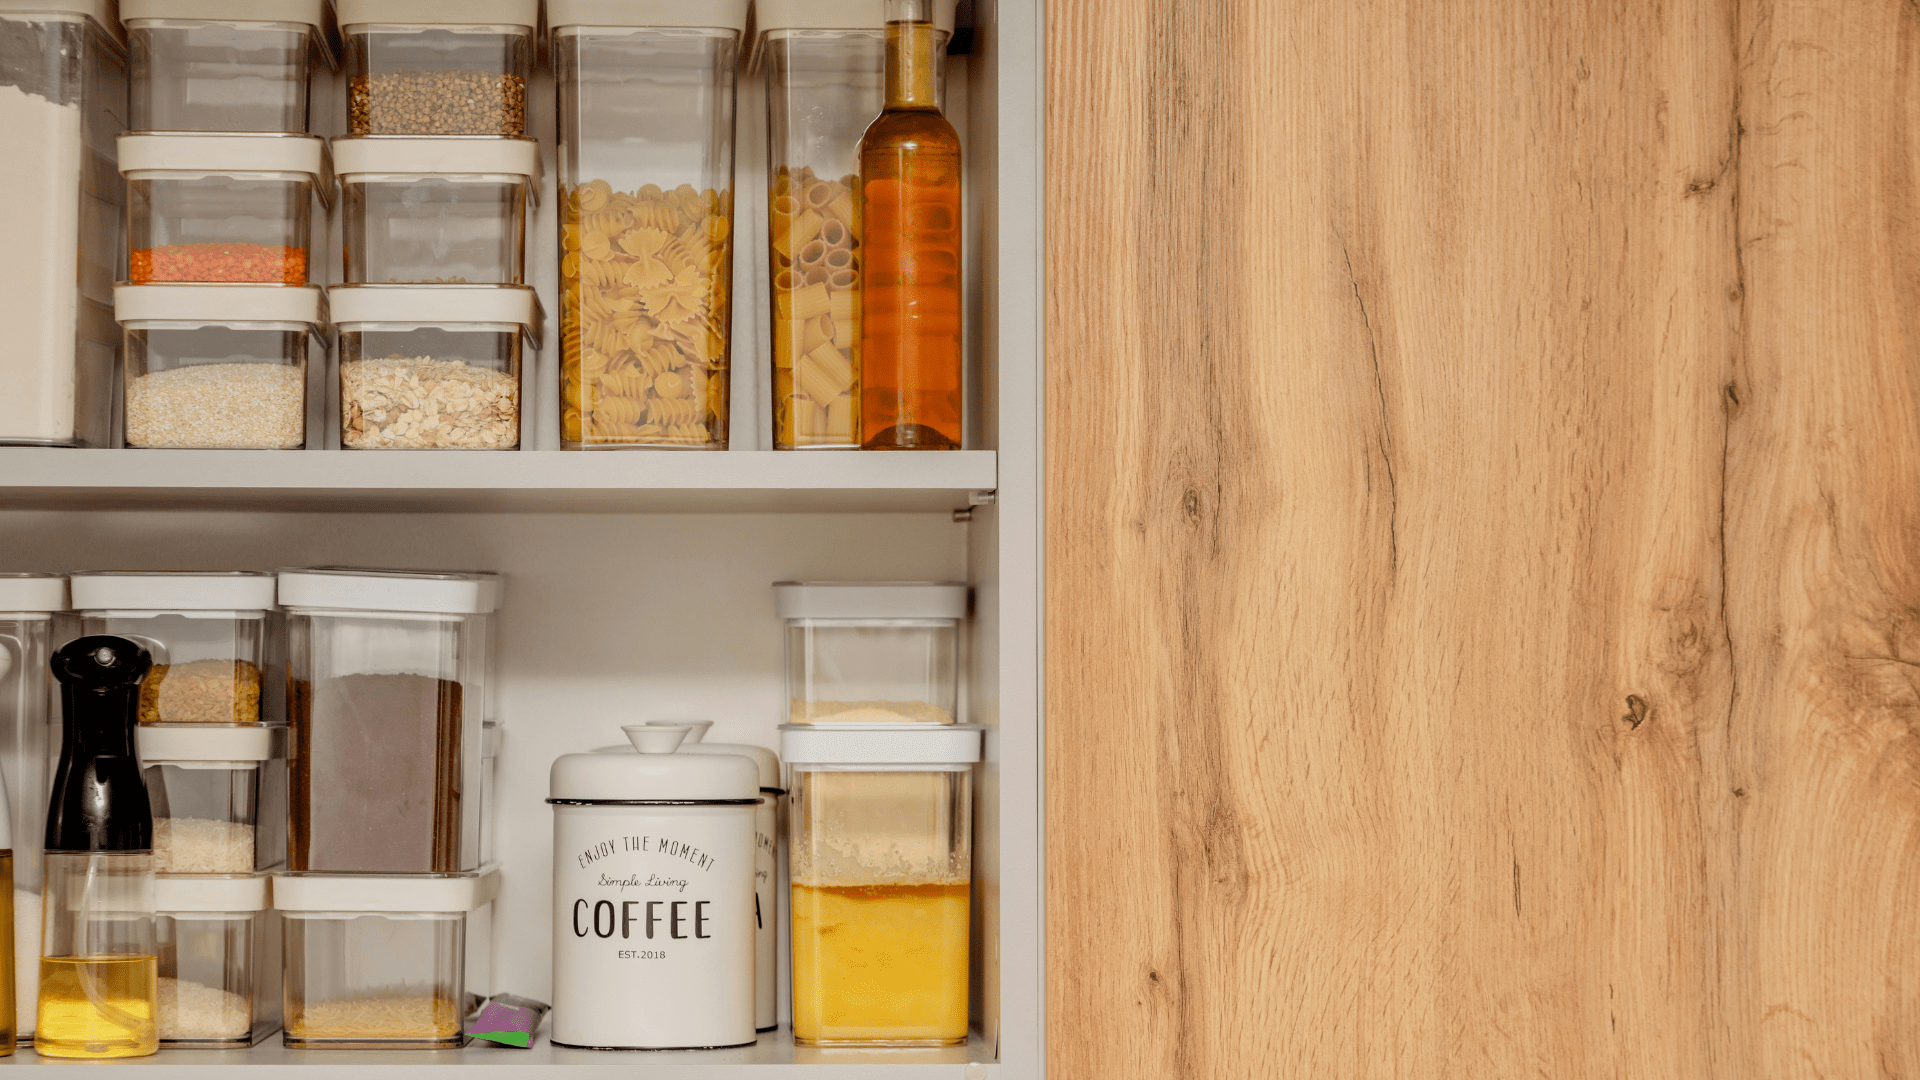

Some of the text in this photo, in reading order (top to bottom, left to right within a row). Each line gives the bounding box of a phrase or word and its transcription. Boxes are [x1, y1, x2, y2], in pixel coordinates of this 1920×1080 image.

[578, 836, 715, 872] ENJOY THE MOMENT
[598, 873, 689, 892] Simple Living
[573, 898, 711, 940] COFFEE
[618, 950, 666, 960] EST.2018
